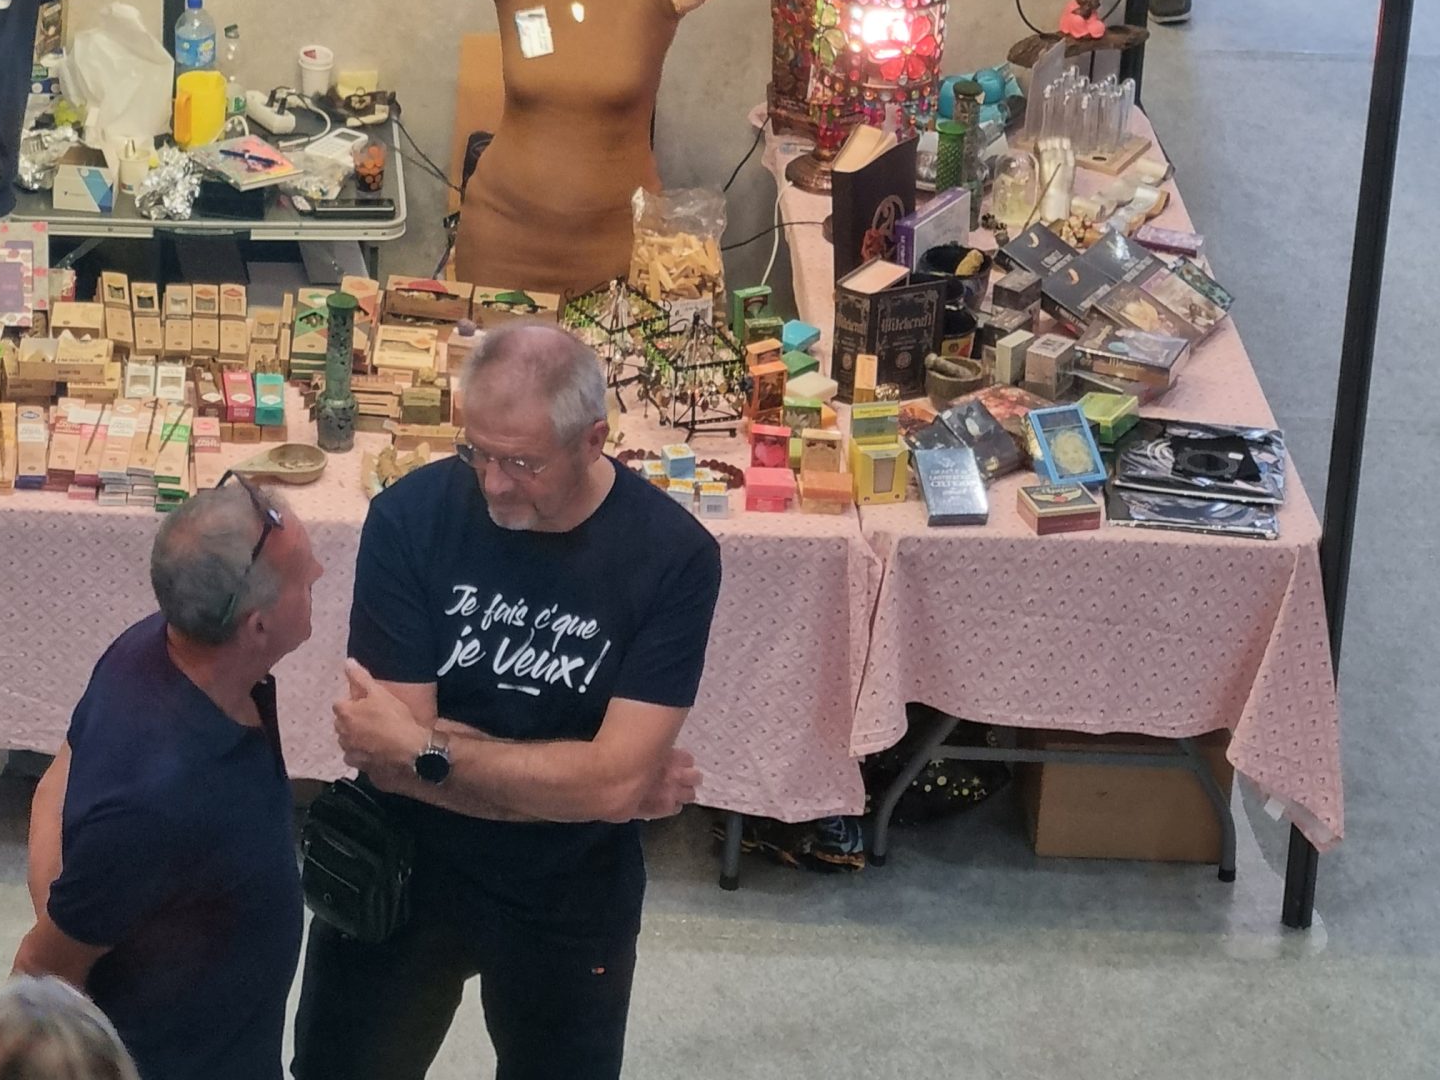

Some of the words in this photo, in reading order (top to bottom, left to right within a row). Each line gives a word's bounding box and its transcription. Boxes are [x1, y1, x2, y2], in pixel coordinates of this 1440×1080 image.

[444, 584, 481, 617] Je
[480, 593, 530, 631] fais
[534, 602, 601, 653] c'que
[436, 624, 487, 677] je
